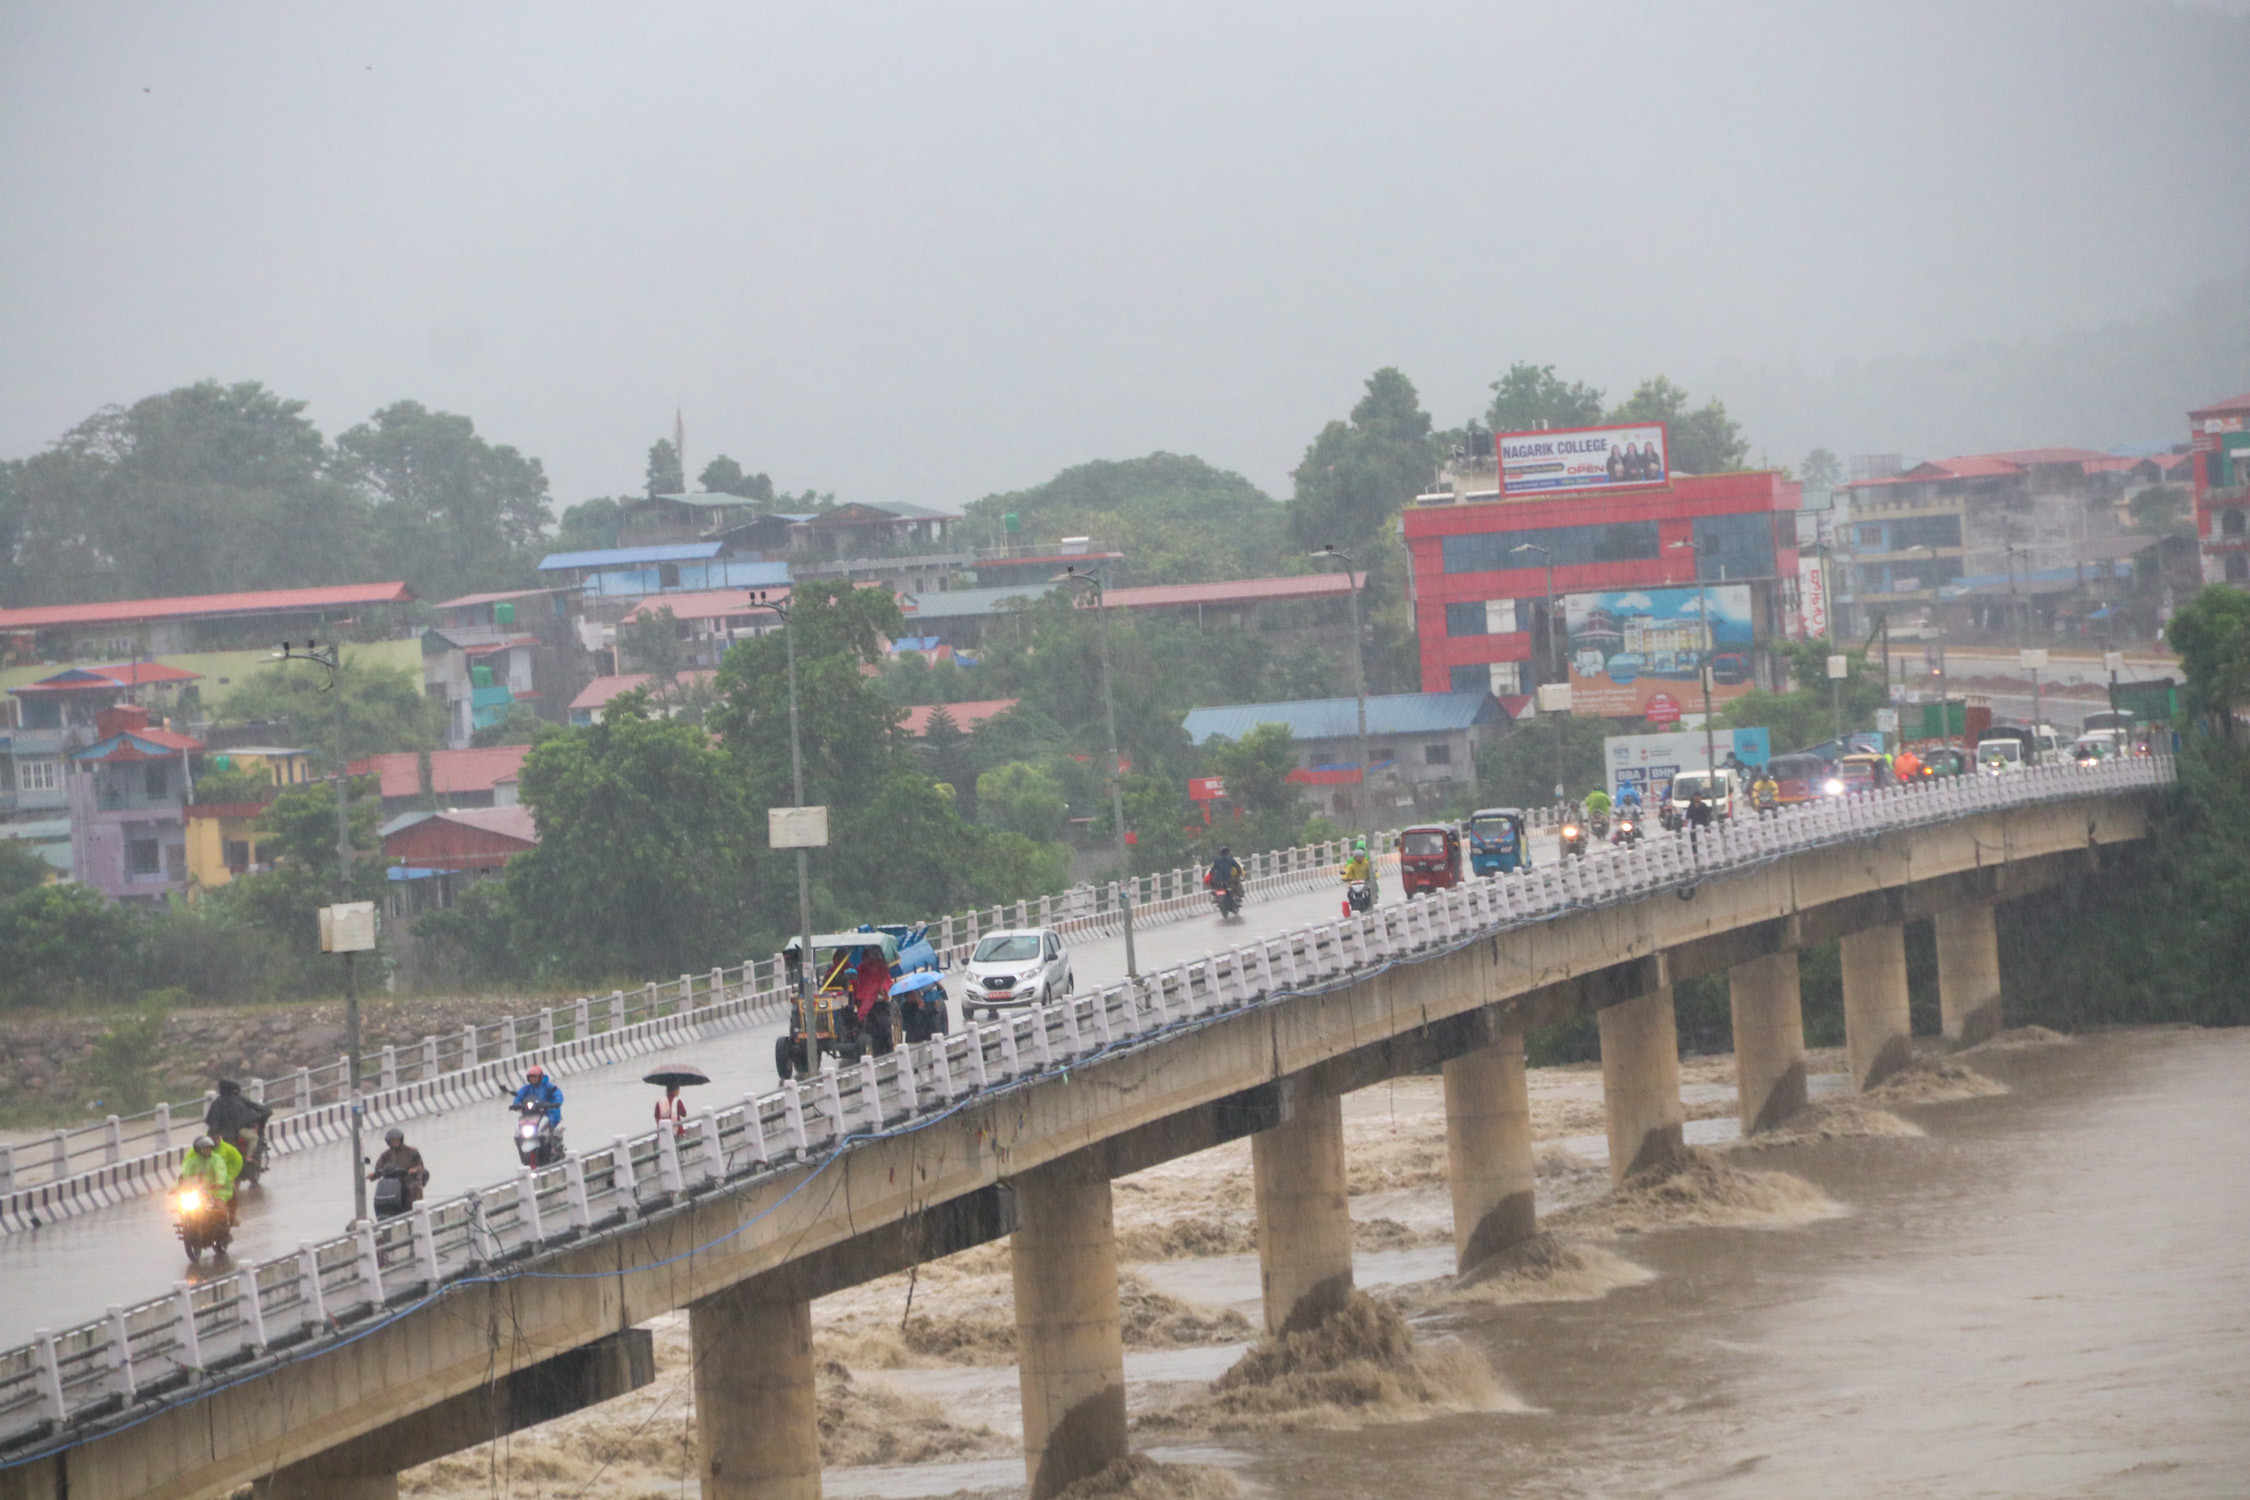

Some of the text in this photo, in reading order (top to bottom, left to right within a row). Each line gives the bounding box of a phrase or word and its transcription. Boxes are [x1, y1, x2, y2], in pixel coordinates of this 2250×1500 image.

[1502, 438, 1608, 459] NAGARIK COLLEGE
[1567, 464, 1605, 475] OPEN
[1617, 769, 1641, 780] BBA
[1652, 767, 1675, 778] BHM
